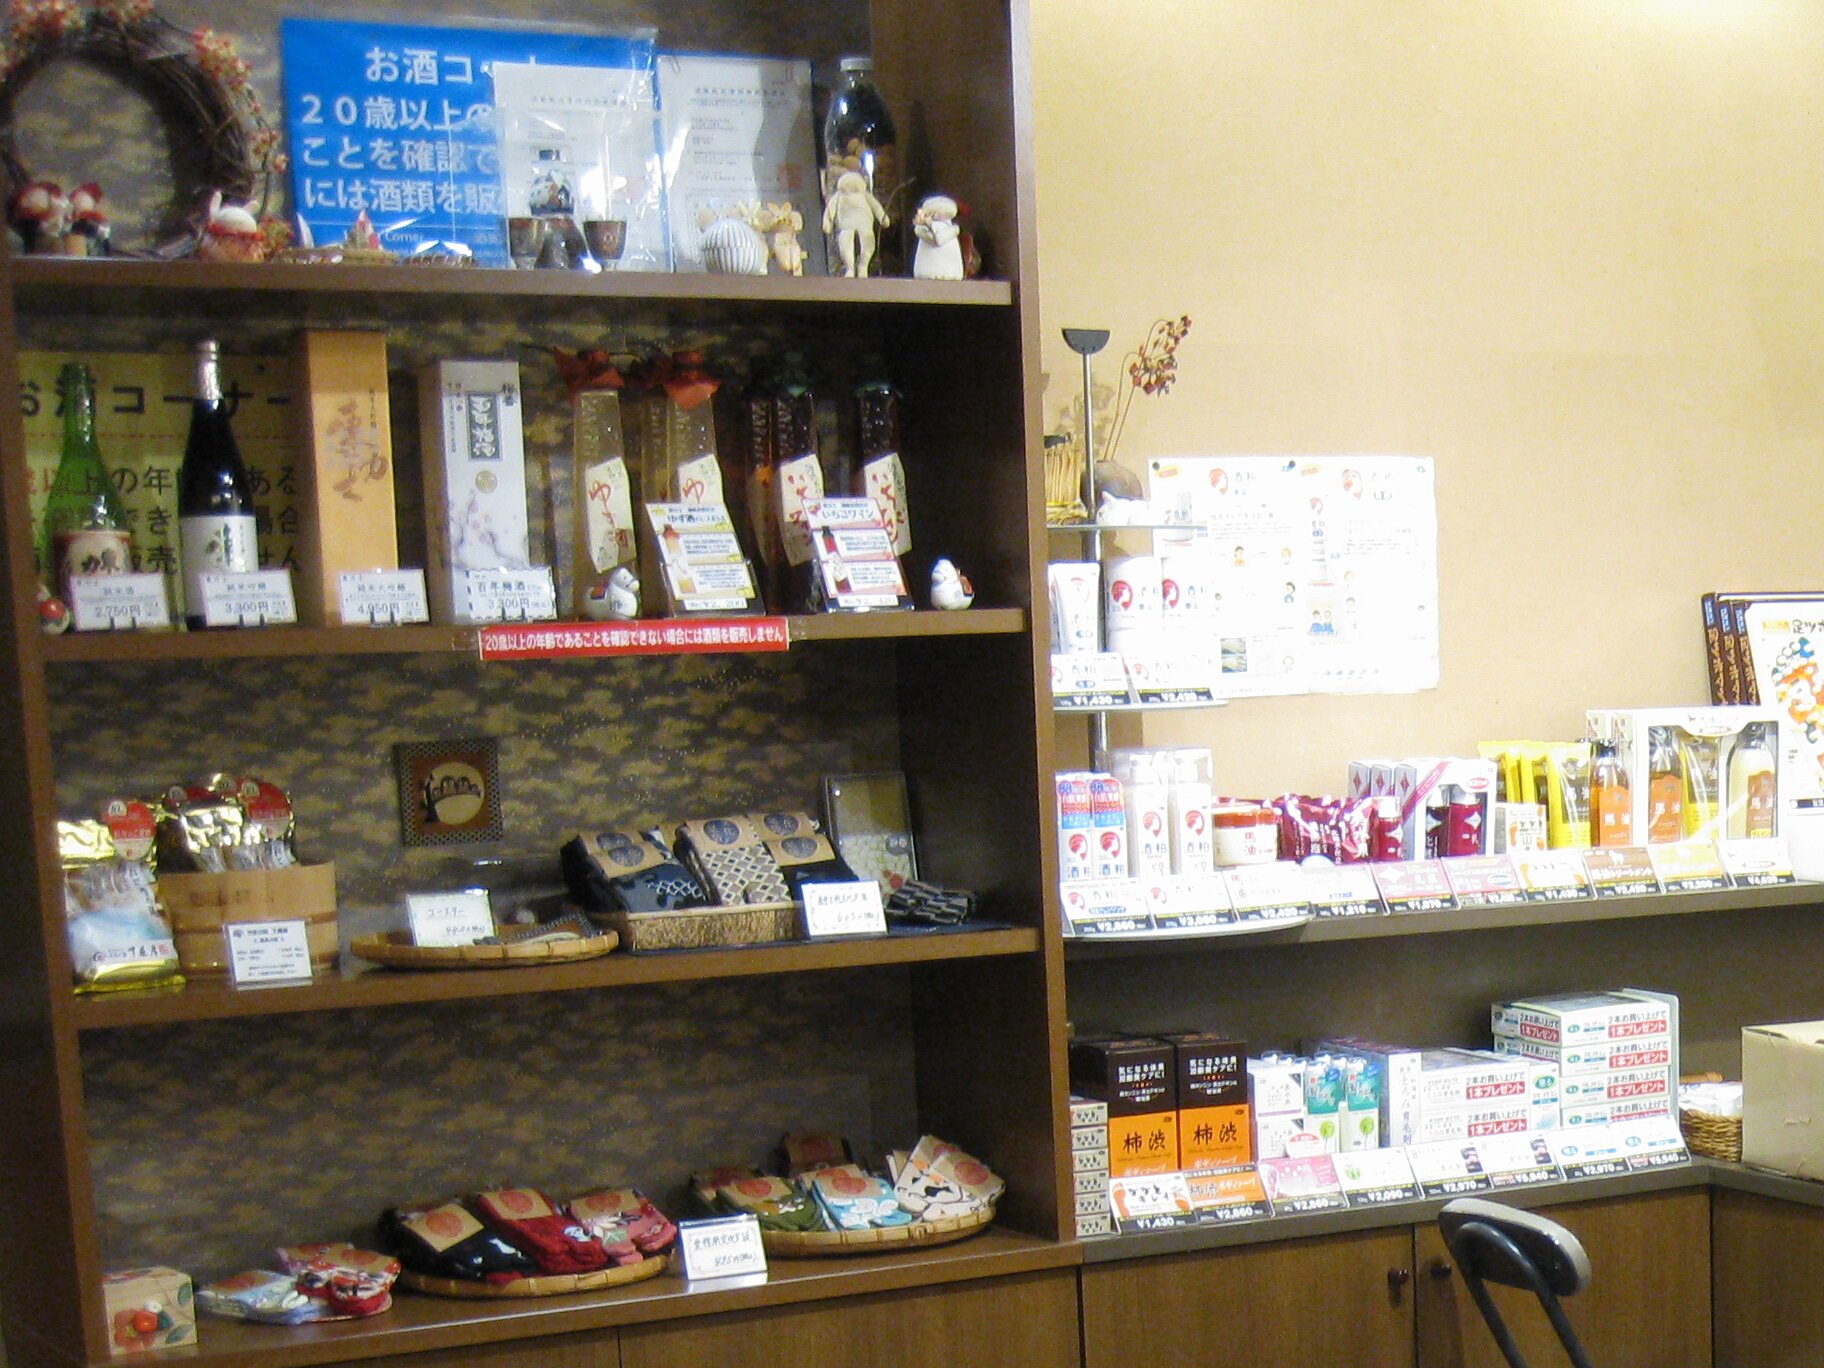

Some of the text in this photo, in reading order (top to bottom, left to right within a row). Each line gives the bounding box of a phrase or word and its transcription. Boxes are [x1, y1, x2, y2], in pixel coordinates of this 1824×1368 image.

[477, 581, 527, 594] 百年梅酒
[1607, 1010, 1667, 1024] 2本お買い上げで
[1519, 1024, 1560, 1043] 1本プレゼント
[1608, 1020, 1667, 1038] 1本プレゼント
[1609, 1040, 1668, 1054] 2本お買い上げで
[1609, 1050, 1668, 1068] 1本プレゼント
[1465, 1071, 1525, 1085] 2本お買い上げで
[1606, 1070, 1666, 1085] 2本お買い上げで
[1466, 1081, 1525, 1099] 1本プレゼント
[1606, 1080, 1665, 1098] 1本プレゼント
[1609, 1100, 1669, 1115] 2本お買い上げで
[1467, 1109, 1528, 1124] 2本お買い上げで
[1193, 1120, 1239, 1146] 柿渋
[1467, 1119, 1527, 1137] 1本プレゼント
[1123, 1128, 1166, 1154] 柿渋
[1216, 1207, 1254, 1221] ¥2,860
[1136, 1215, 1175, 1230] ¥1,430
